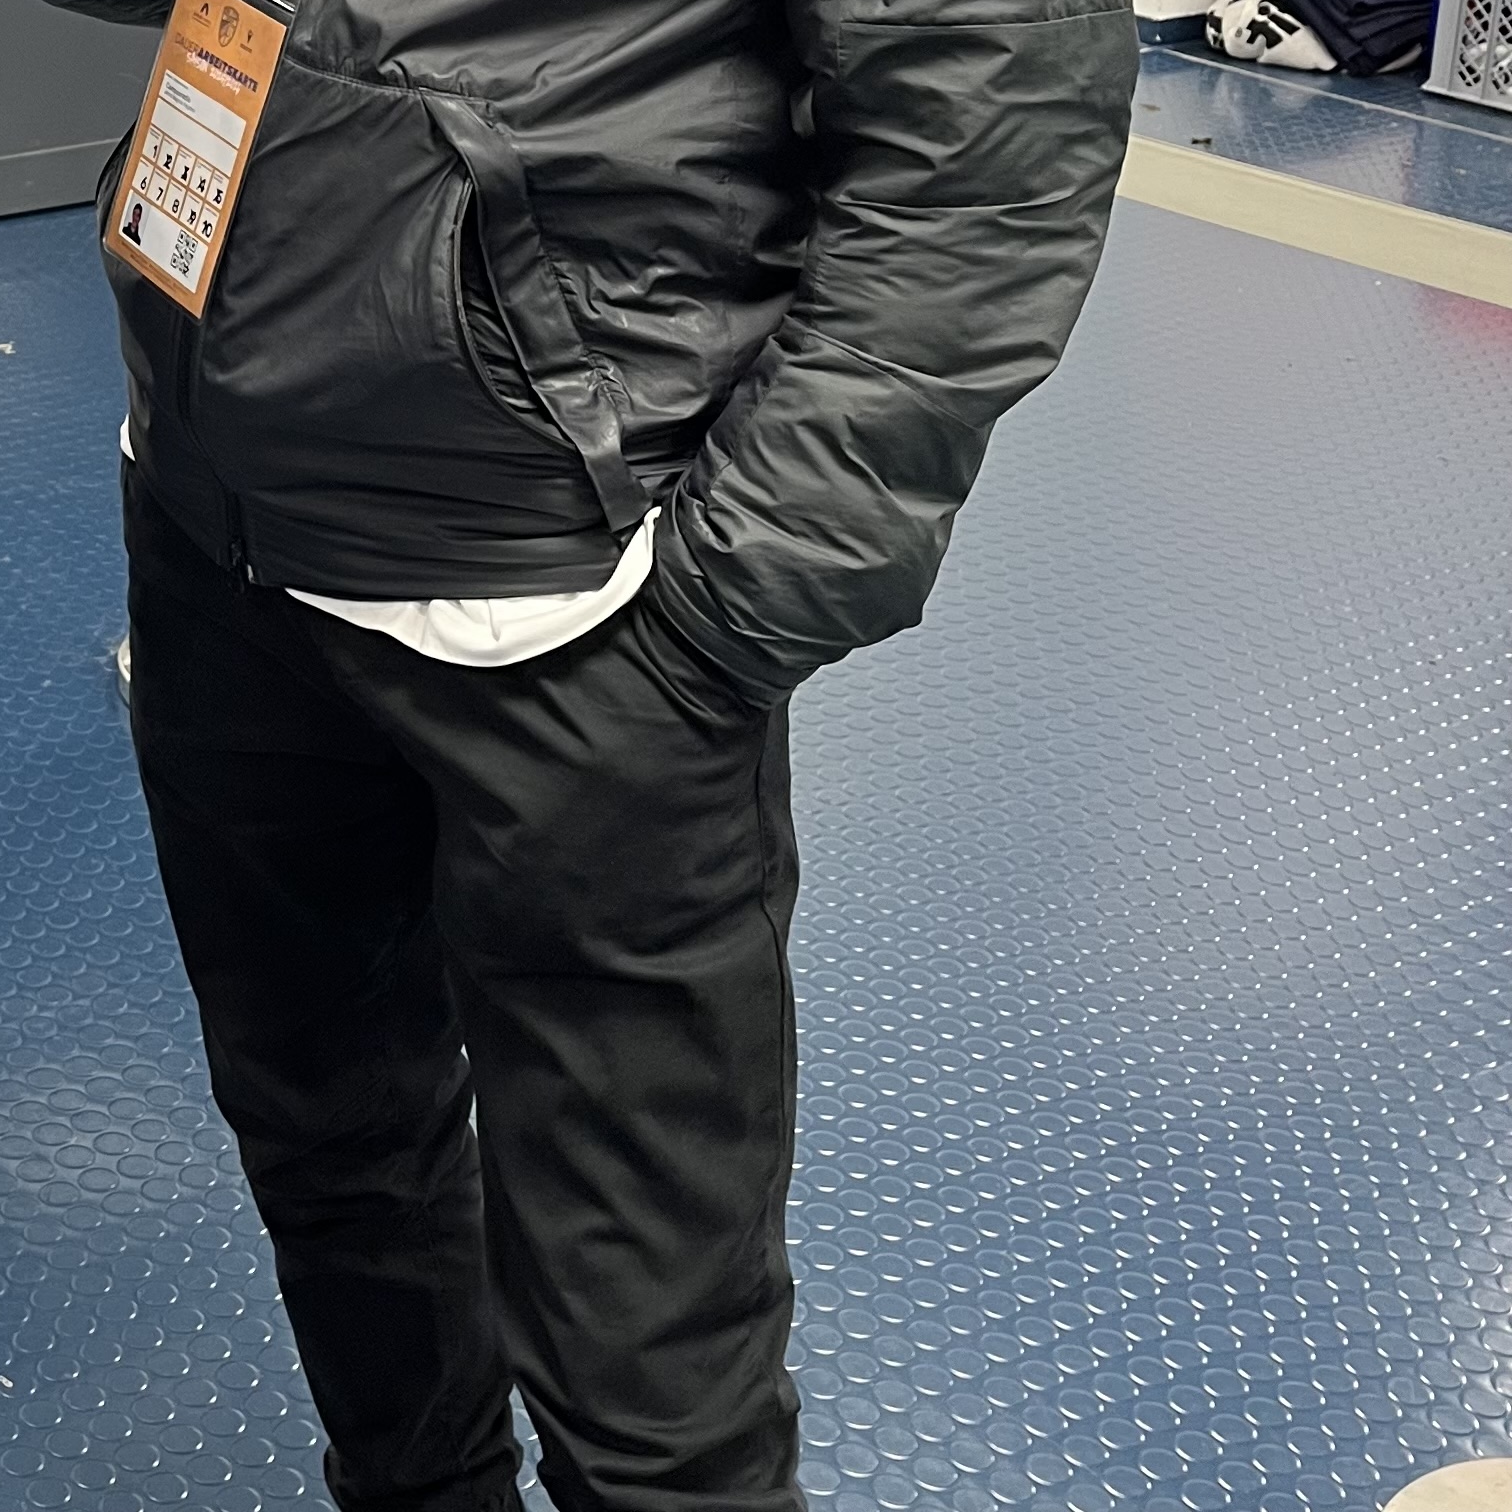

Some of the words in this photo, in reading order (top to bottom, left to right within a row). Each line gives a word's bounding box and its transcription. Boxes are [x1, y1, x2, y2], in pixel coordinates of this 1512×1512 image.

[140, 177, 148, 191] 6
[156, 187, 164, 201] 7
[172, 199, 180, 214] 8
